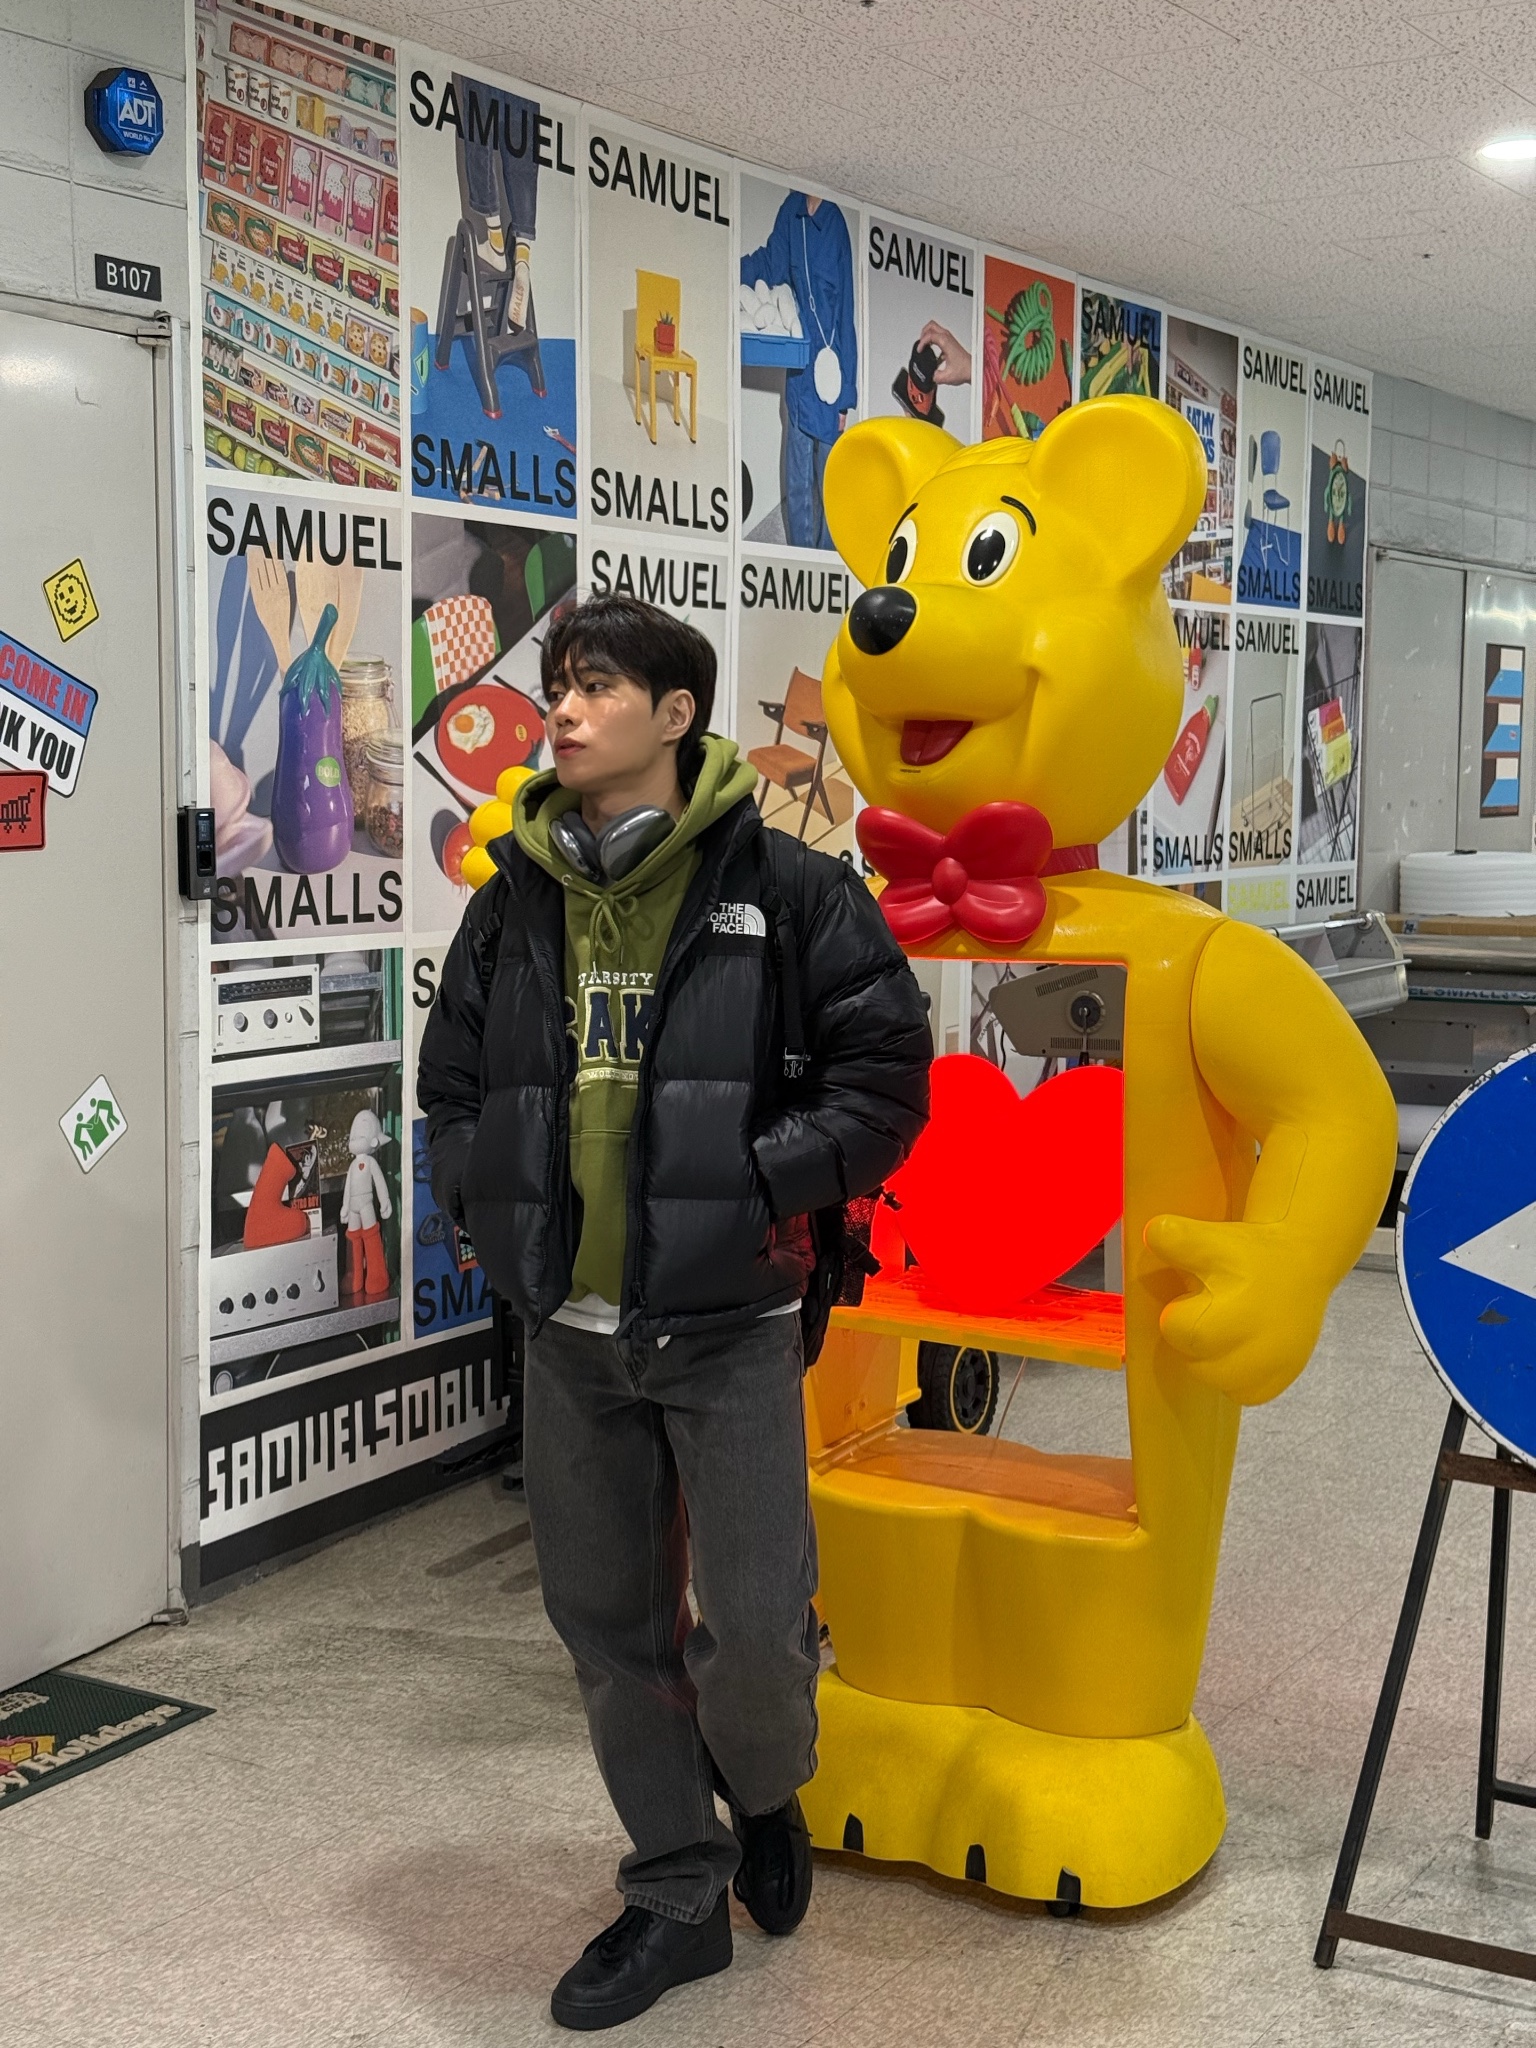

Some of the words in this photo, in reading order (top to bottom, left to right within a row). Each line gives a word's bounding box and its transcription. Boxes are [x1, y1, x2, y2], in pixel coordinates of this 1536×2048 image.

[119, 97, 155, 128] ADT
[409, 70, 575, 176] SAMUEL
[123, 130, 143, 141] WORLD
[588, 136, 730, 227] SAMUEL
[106, 262, 151, 292] B107
[868, 226, 974, 298] SAMUEL
[1081, 297, 1161, 352] SAMUEL
[1243, 345, 1307, 395] SAMUEL
[1313, 368, 1370, 416] SAMUEL
[411, 434, 576, 508] SMALLS
[591, 467, 729, 533] SMALLS
[207, 498, 402, 572] SAMUEL
[590, 549, 727, 611] SAMUEL
[1236, 564, 1301, 604] SMALLS
[1307, 576, 1363, 612] SMALLS
[1235, 619, 1299, 656] SAMUEL
[61, 683, 89, 726] IN
[27, 720, 76, 780] YOU
[1153, 833, 1224, 870] SMALLS
[1228, 829, 1292, 863] SMALLS
[211, 870, 403, 933] SMALLS
[719, 902, 745, 913] THE
[1296, 875, 1354, 910] SAMUEL
[707, 912, 745, 924] ORTH
[712, 922, 745, 935] FACE
[578, 971, 654, 987] VARSITY
